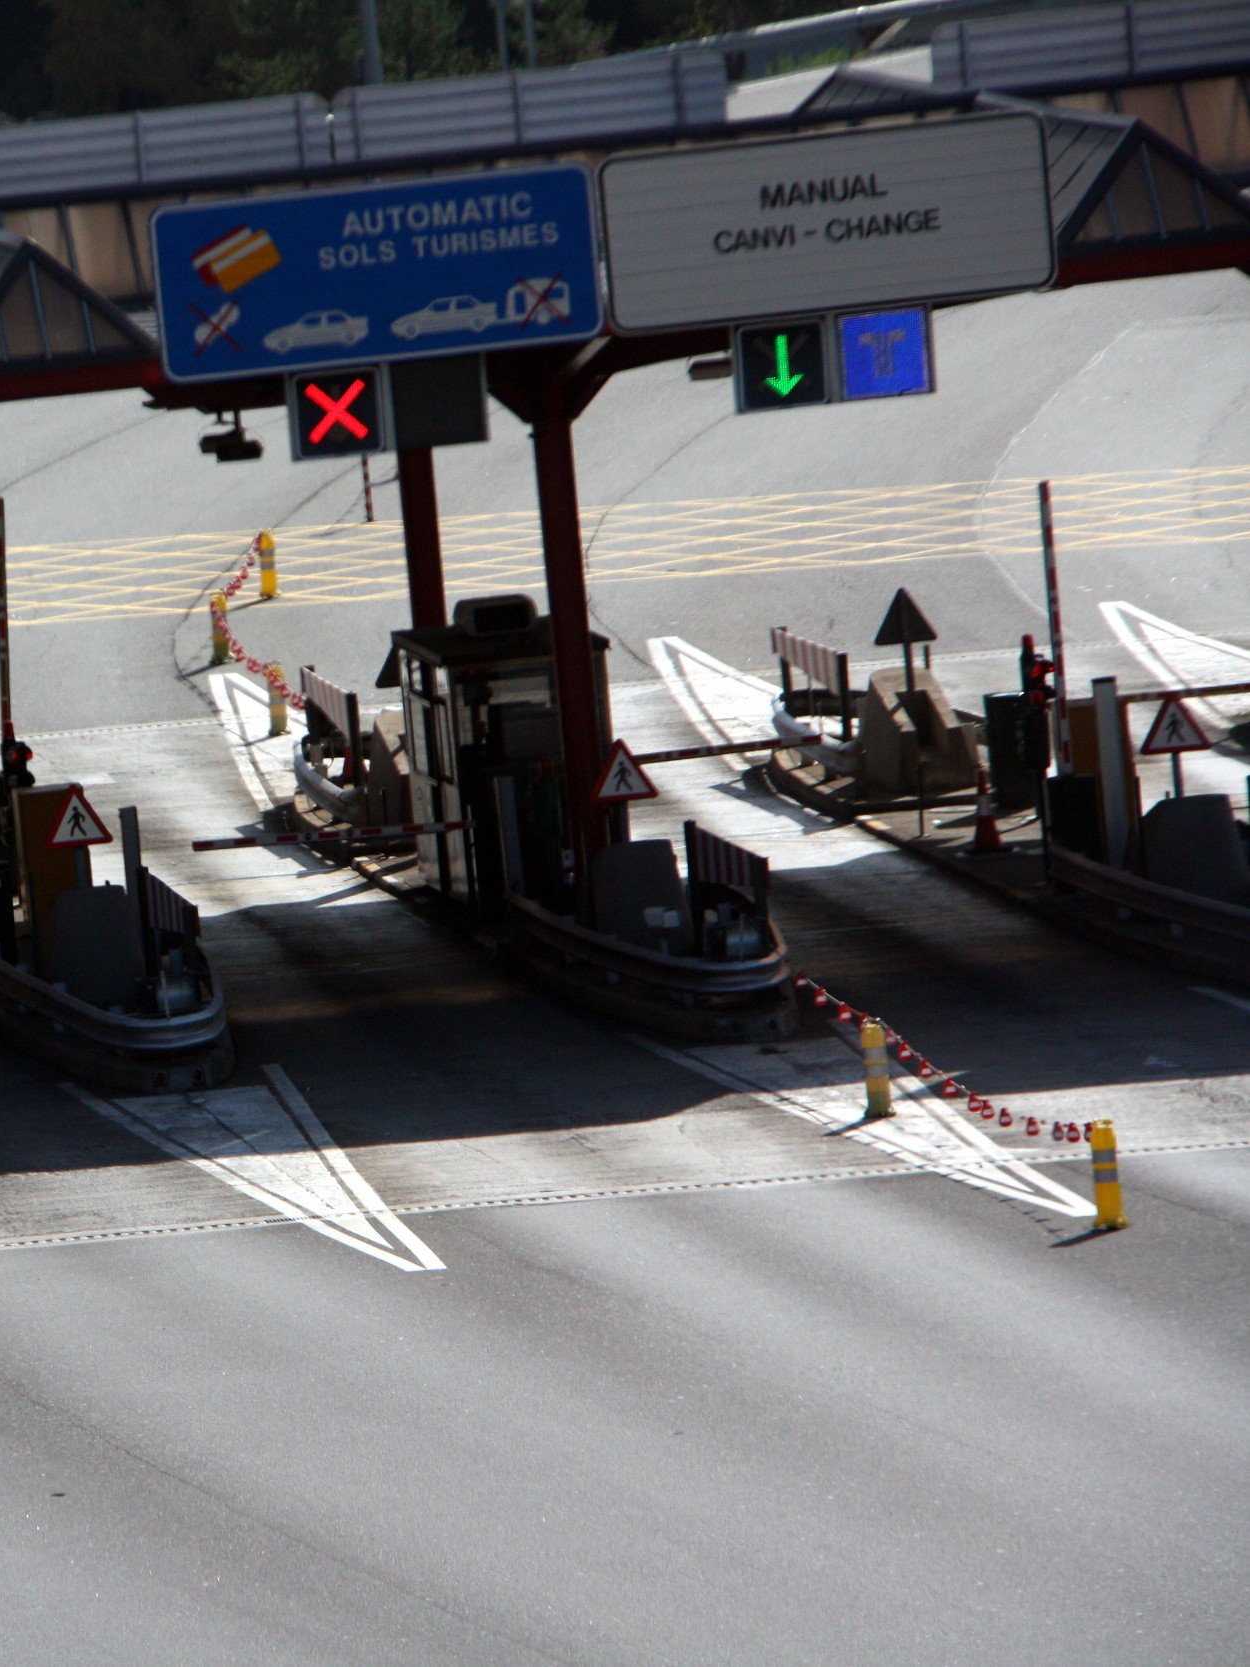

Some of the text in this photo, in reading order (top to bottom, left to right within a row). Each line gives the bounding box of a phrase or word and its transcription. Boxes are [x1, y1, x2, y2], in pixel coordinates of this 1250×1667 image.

[342, 191, 532, 237] AUTOMATIC
[760, 173, 887, 210] MANUAL
[318, 221, 559, 270] SOLS TURISMES
[714, 224, 796, 254] CANVI
[825, 207, 941, 243] CHANGE
